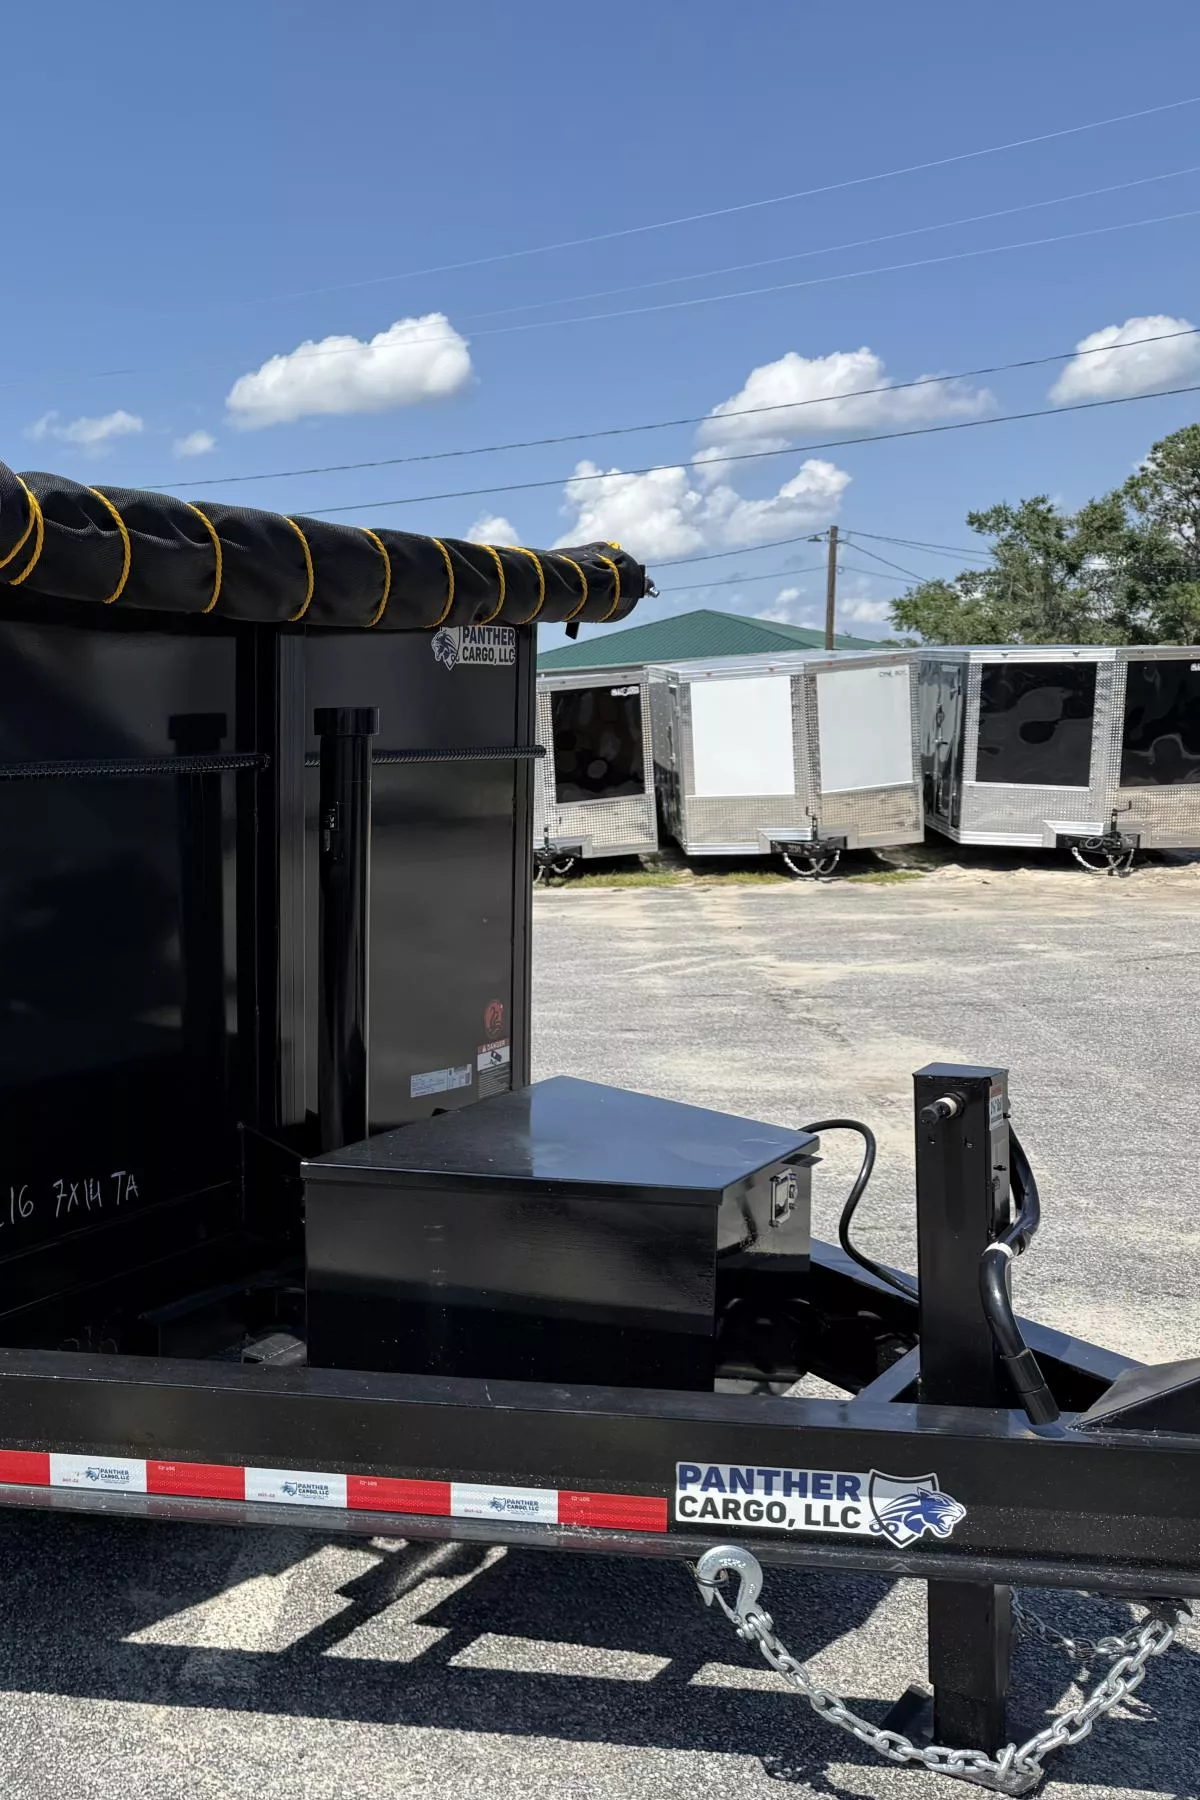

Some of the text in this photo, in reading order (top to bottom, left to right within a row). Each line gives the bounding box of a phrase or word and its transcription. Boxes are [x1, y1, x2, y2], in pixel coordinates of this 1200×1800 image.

[462, 626, 515, 646] PANTHER
[462, 646, 515, 665] CARGO, LLC
[110, 1170, 139, 1206] TA
[678, 1464, 862, 1501] PANTHER
[678, 1495, 862, 1529] CARGO, LLC
